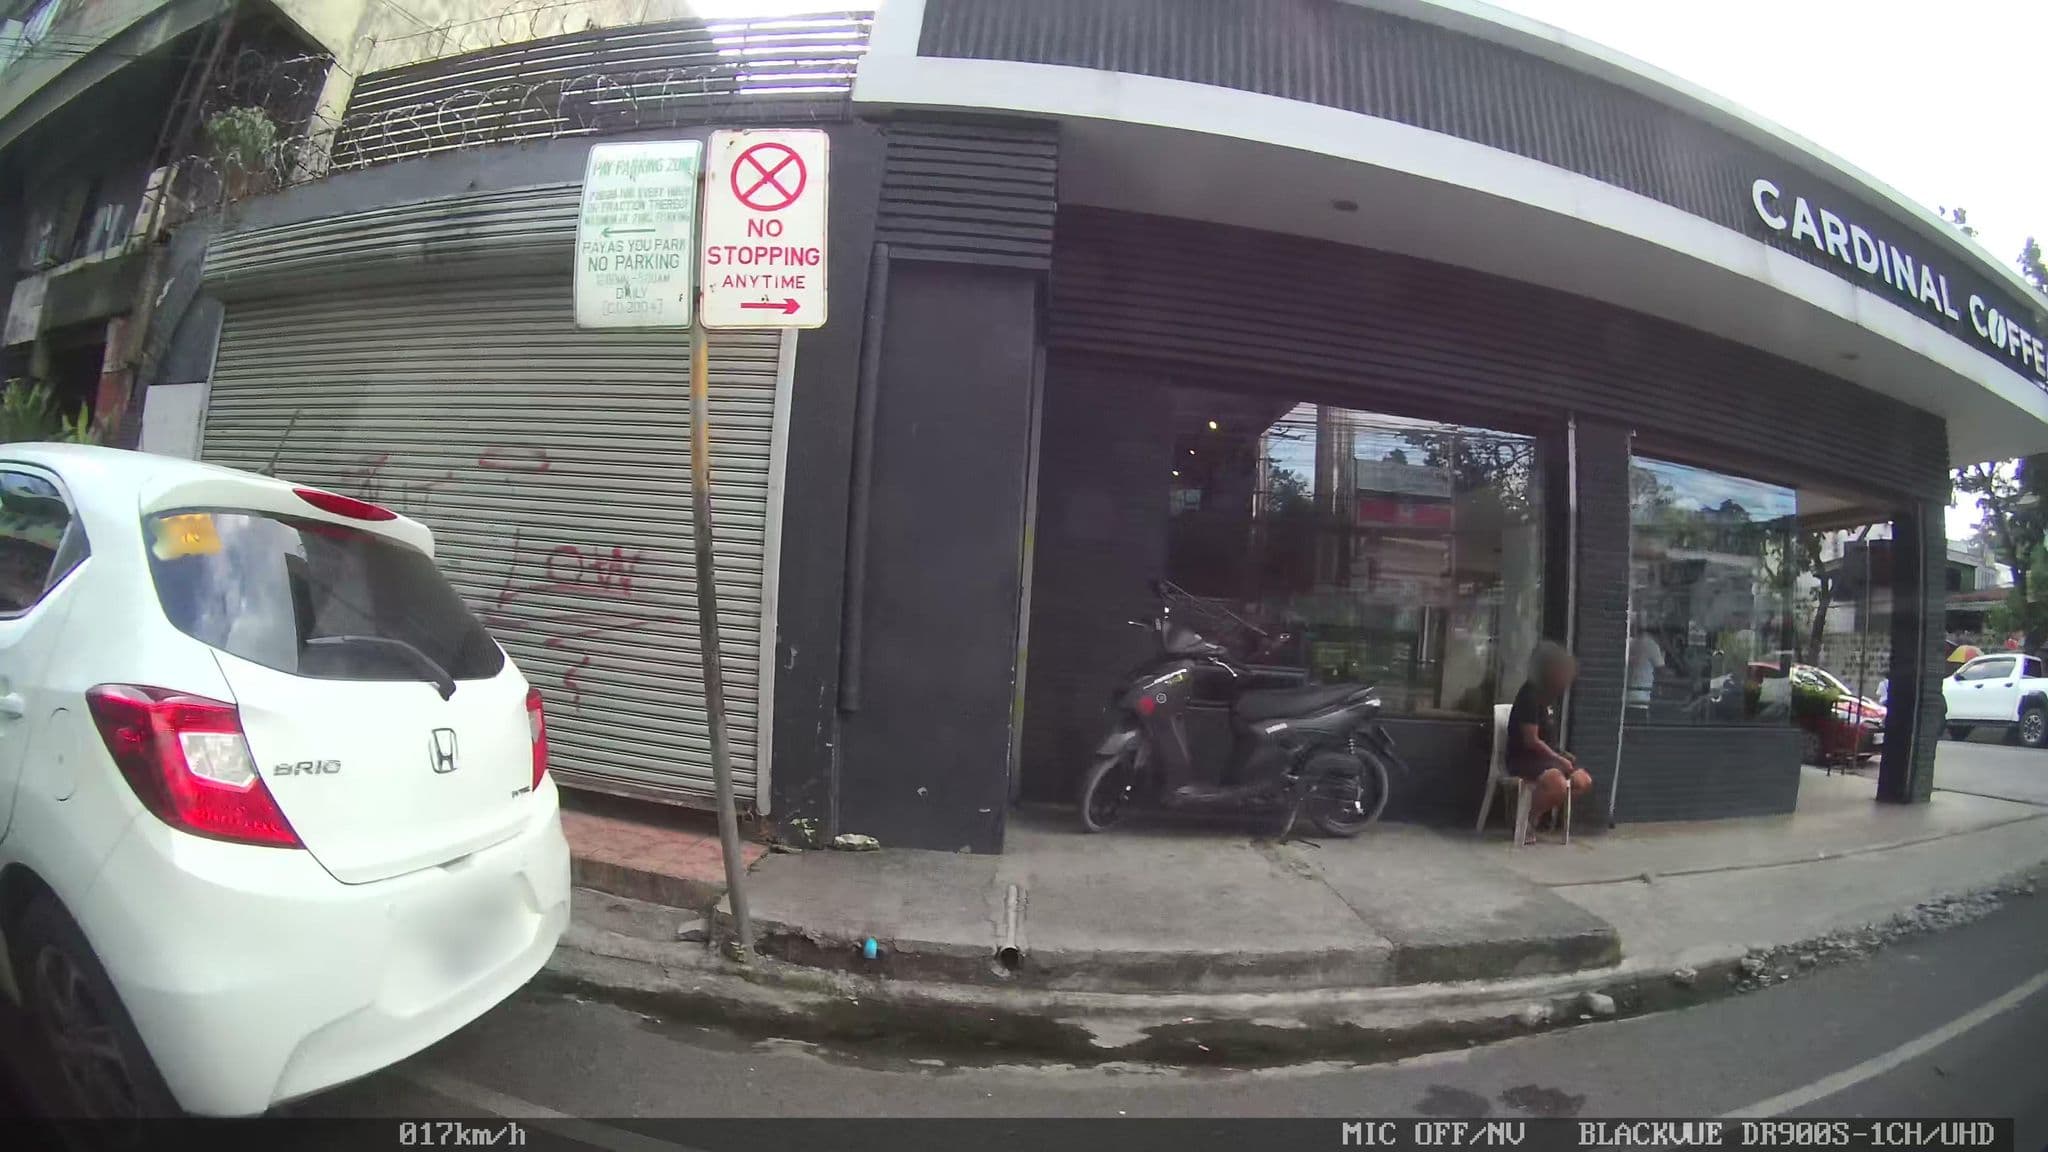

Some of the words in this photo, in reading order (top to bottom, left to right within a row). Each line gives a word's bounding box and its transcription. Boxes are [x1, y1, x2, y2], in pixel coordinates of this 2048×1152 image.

[747, 219, 783, 237] NO
[628, 239, 652, 252] YOU
[655, 238, 686, 251] PARK
[588, 255, 609, 272] NO
[615, 253, 680, 270] PARKING
[707, 246, 820, 266] STOPPING
[722, 274, 806, 289] ANYTIME
[1752, 179, 1959, 320] CARDINAL
[1969, 294, 2048, 380] COFFE
[616, 286, 648, 300] DAILY
[273, 759, 342, 776] BRIO
